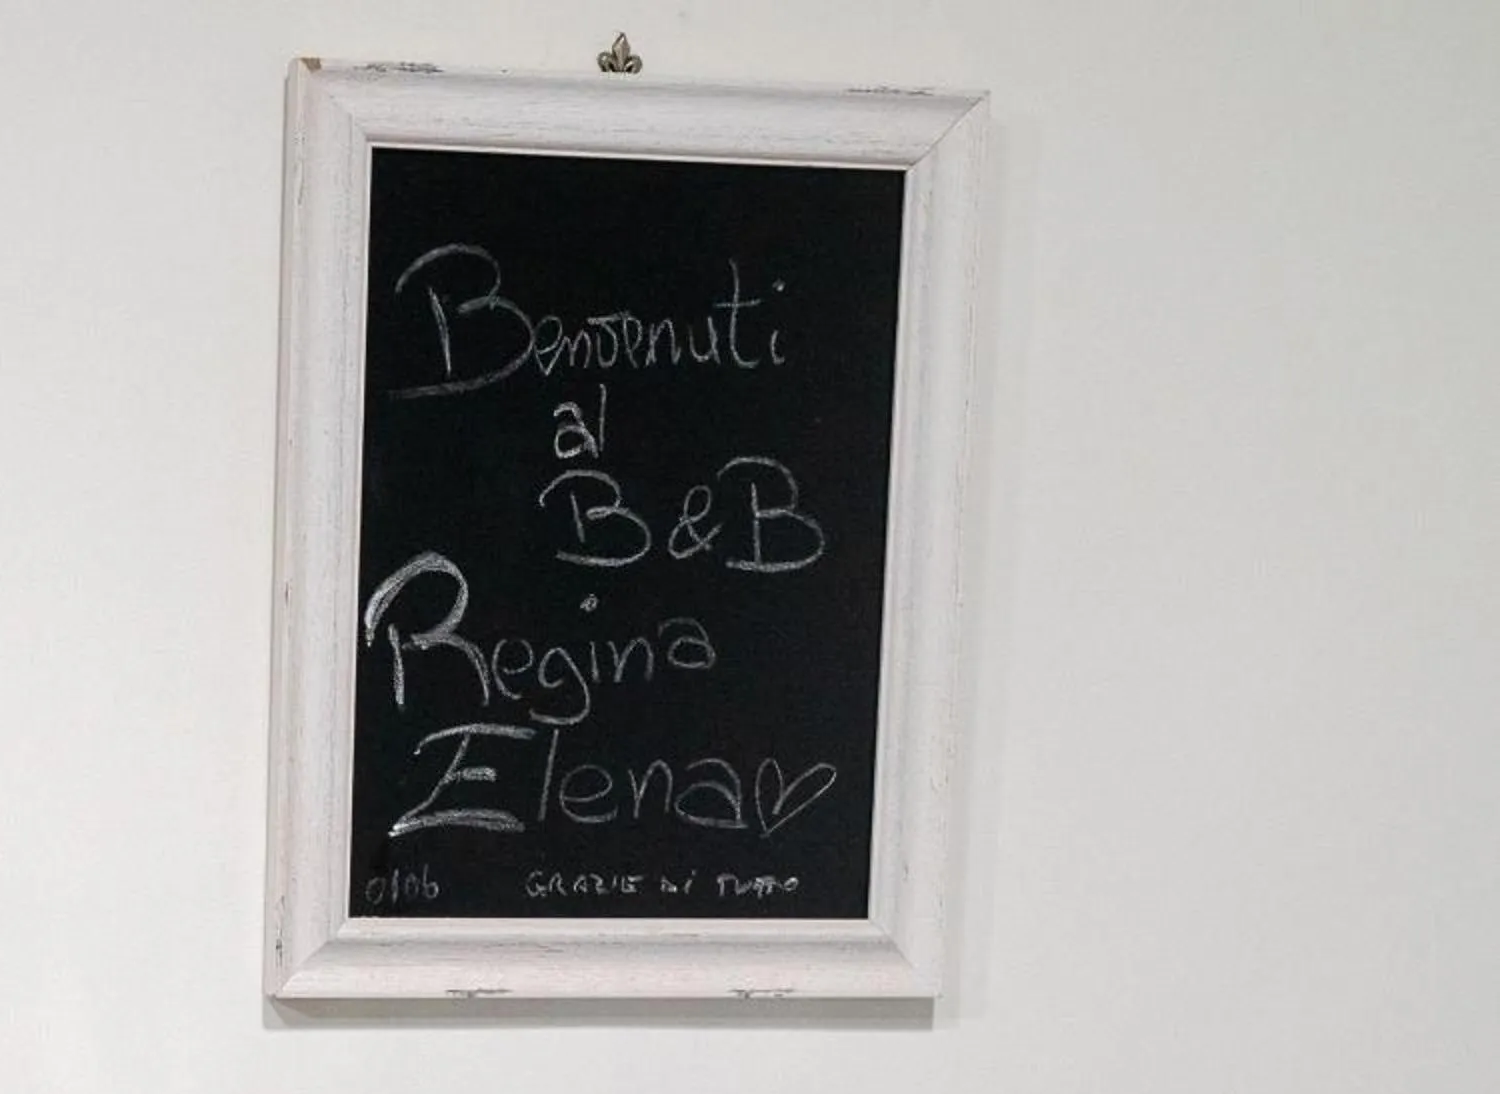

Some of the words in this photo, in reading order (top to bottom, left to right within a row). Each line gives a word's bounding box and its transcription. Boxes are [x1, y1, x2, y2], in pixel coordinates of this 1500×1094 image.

[388, 241, 787, 400] Benvenuti
[552, 382, 607, 460] al
[362, 551, 717, 726] Regina
[387, 722, 748, 837] Elena
